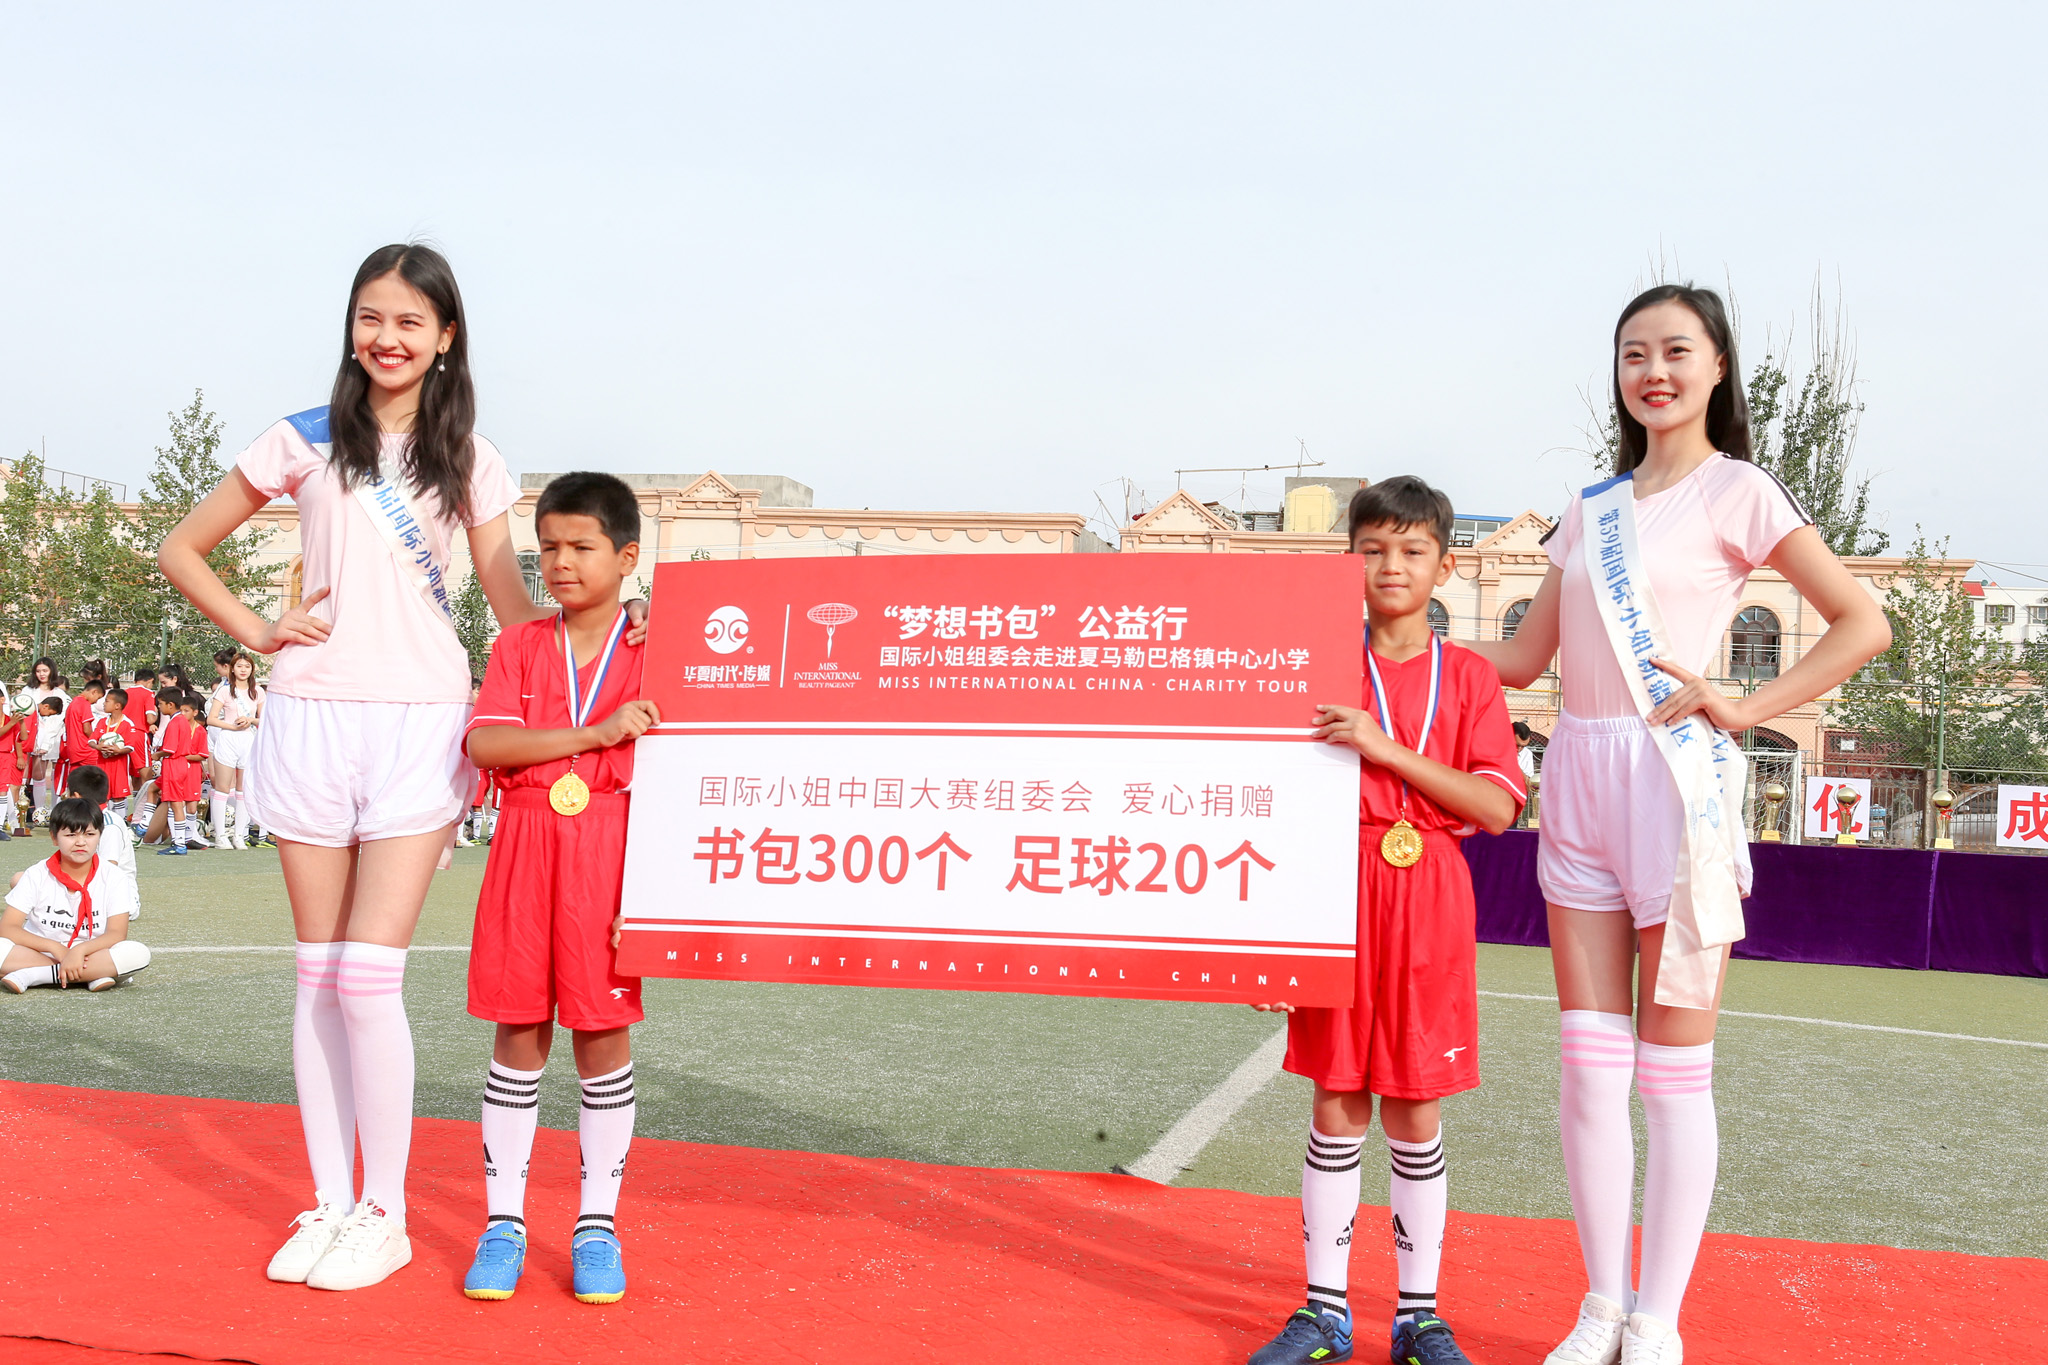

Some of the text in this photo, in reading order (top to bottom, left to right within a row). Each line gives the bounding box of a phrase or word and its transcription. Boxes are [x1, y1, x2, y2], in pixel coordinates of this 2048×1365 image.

[1078, 605, 1188, 642] 公益行
[818, 662, 839, 671] MISS
[880, 645, 1310, 672] 国际小姐组委会走进夏马勒巴格镇中心小学
[793, 671, 862, 681] INTERNATIONAL
[878, 676, 920, 690] MISS
[930, 676, 1077, 691] INTERNATIONAL
[1086, 677, 1144, 691] CHINA
[1166, 678, 1247, 693] CHARITY
[1257, 680, 1308, 694] TOUR
[698, 775, 1274, 819] 国际小姐中国大赛组委会 爱心捐赠
[693, 826, 1277, 902] 书包300个 足球20个
[46, 905, 51, 913] I
[666, 950, 1299, 987] MISS INTERNATIONAL CHINA
